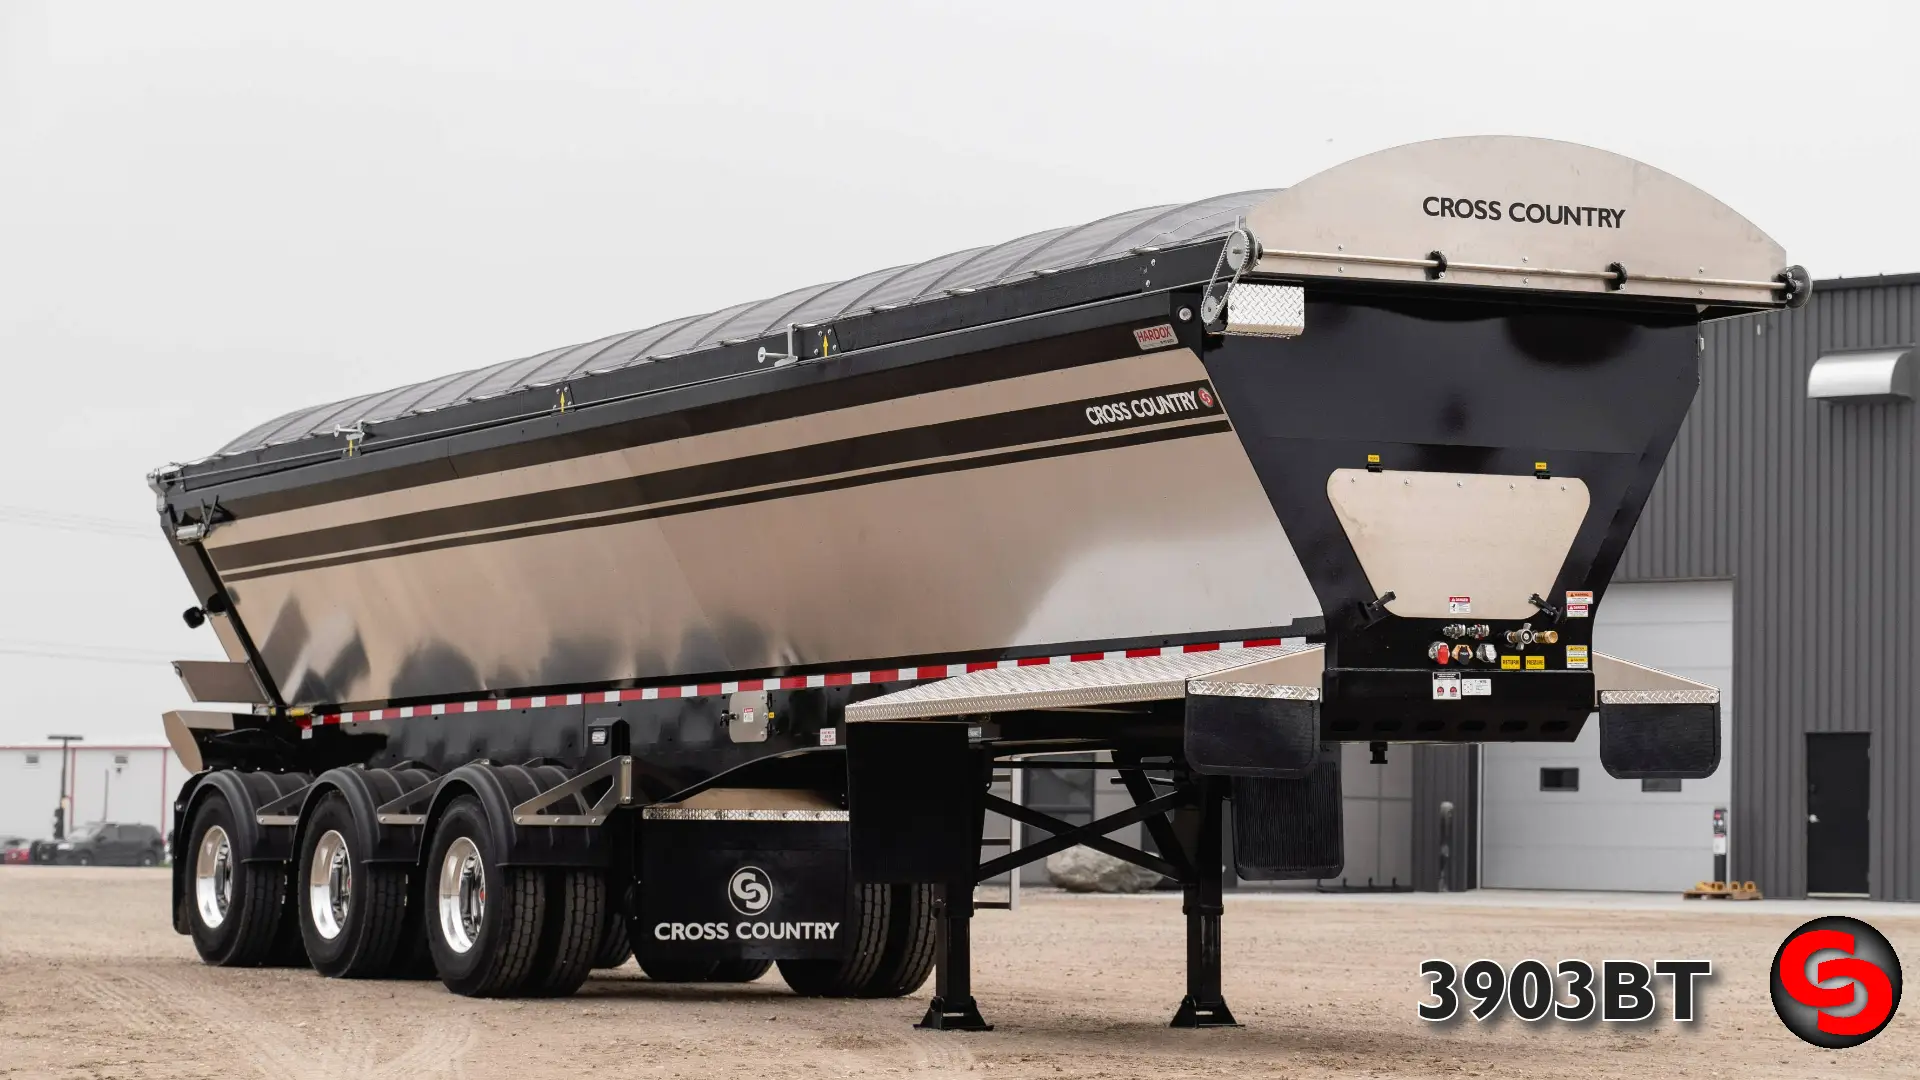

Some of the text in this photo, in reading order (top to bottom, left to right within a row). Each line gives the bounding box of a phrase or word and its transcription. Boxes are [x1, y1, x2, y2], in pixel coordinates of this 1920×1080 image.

[1422, 196, 1626, 229] CROSS COUNTRY
[1136, 326, 1171, 342] HARDOX
[1085, 391, 1199, 425] CROSS COUNTRY
[654, 922, 840, 941] CROSS COUNTRY
